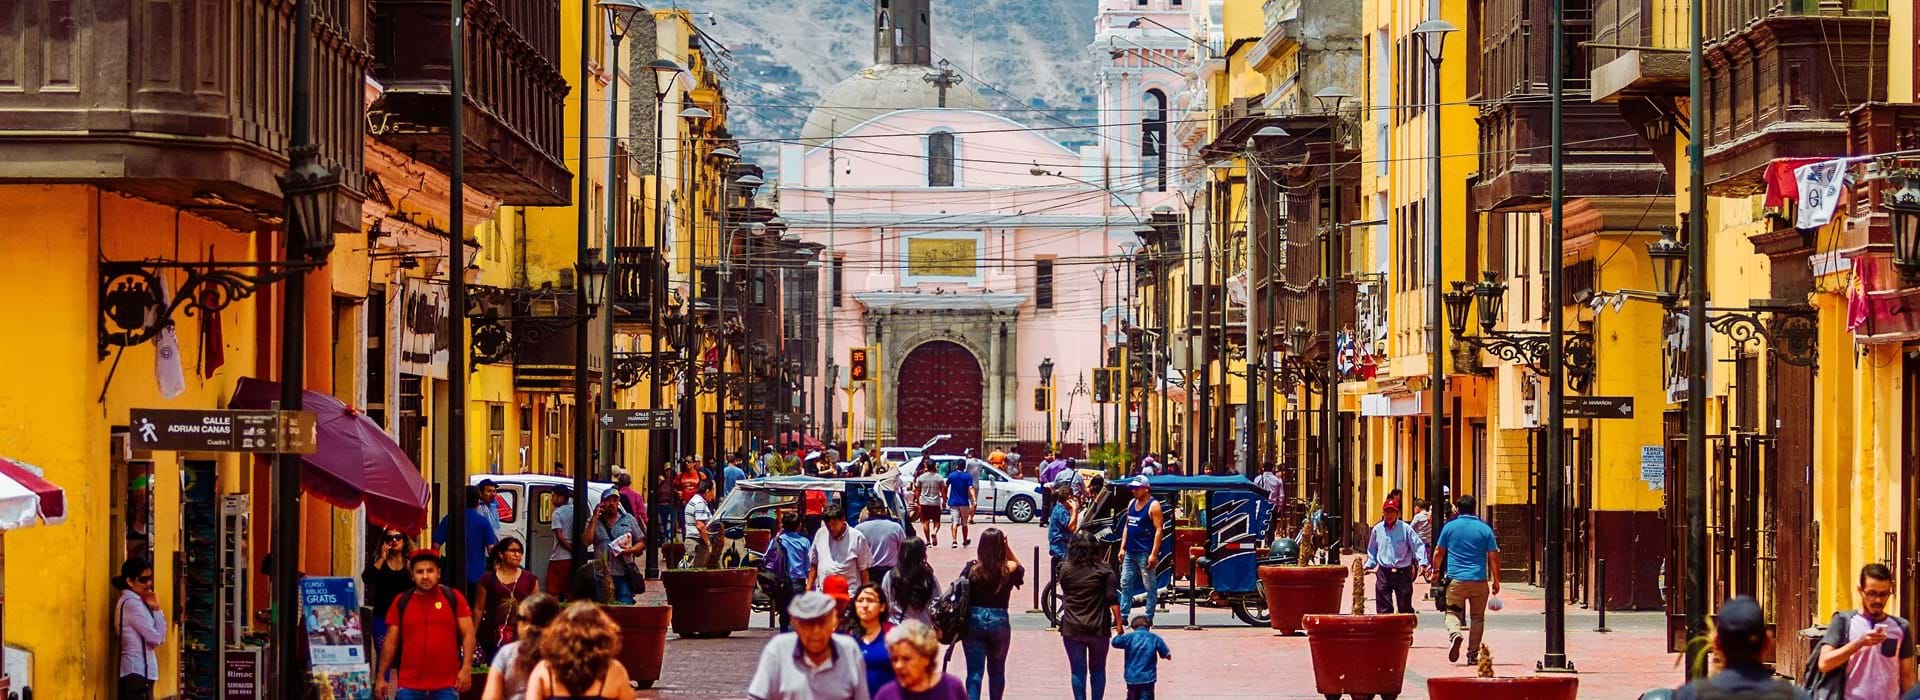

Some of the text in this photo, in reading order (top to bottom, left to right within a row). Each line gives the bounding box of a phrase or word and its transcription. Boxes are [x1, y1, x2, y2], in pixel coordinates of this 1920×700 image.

[853, 352, 864, 361] 35
[203, 417, 231, 425] CALLE
[168, 425, 200, 433] ADRIAN
[306, 594, 337, 604] GRATIS
